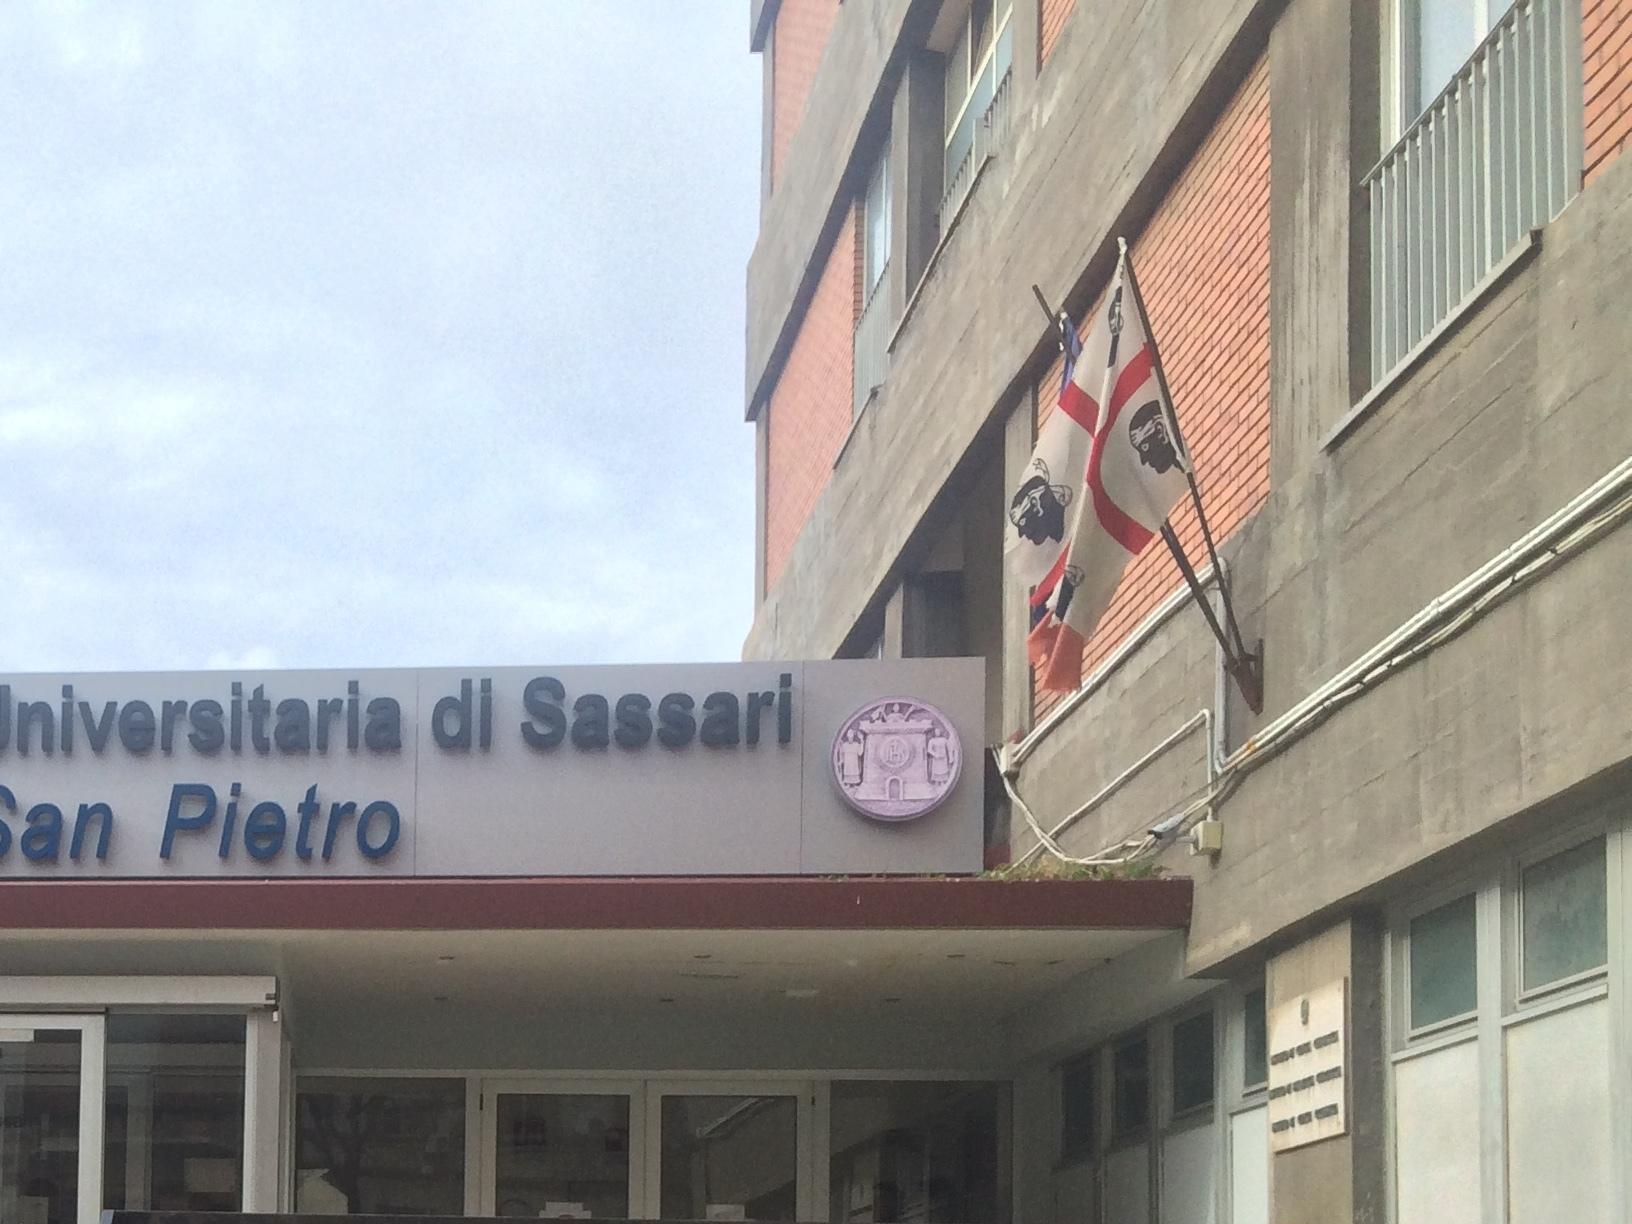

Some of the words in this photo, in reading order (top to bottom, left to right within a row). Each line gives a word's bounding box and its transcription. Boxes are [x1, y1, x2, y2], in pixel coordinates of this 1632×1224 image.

[432, 677, 493, 749] di
[520, 672, 793, 750] Sassari
[160, 781, 401, 862] Pietro
